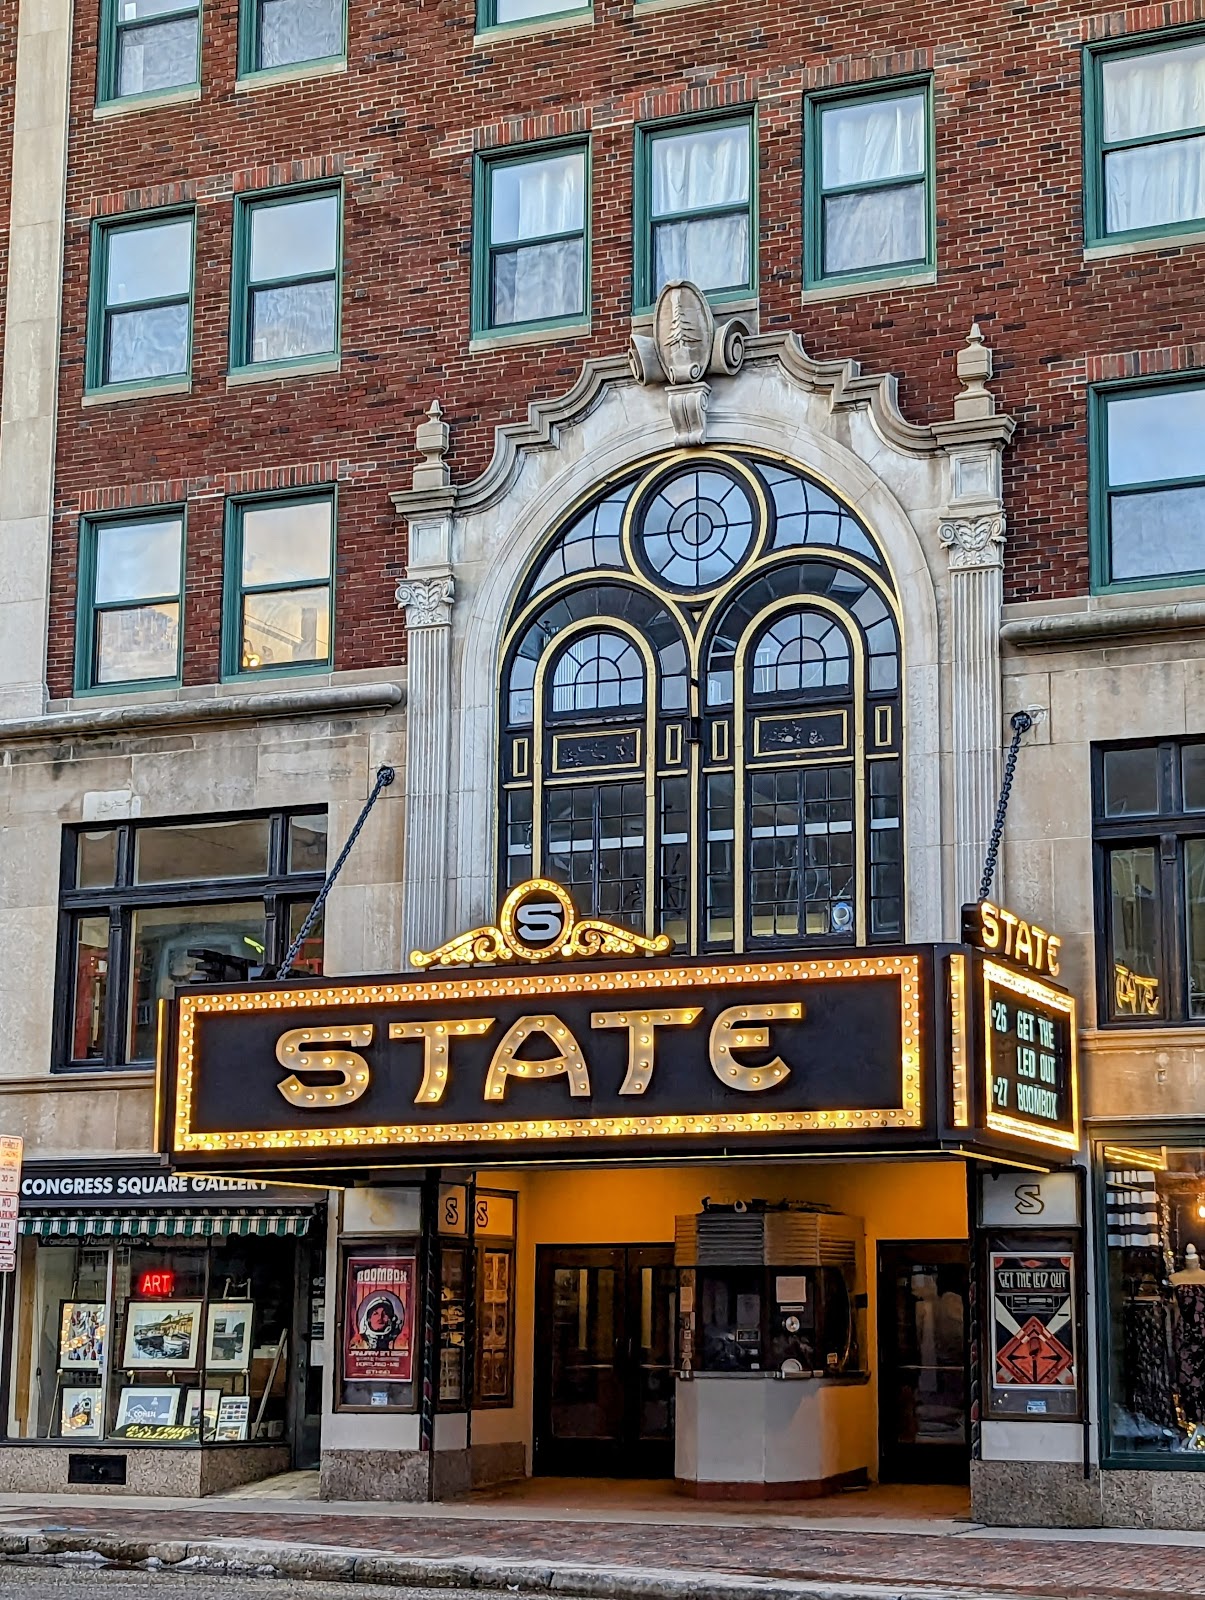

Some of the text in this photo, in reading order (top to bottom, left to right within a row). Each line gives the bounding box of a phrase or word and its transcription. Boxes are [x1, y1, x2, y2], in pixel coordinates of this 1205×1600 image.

[516, 903, 563, 941] S
[980, 901, 1062, 977] STATE
[1016, 1009, 1035, 1043] GET
[1037, 1017, 1056, 1051] THE
[275, 1002, 802, 1108] STATE
[1016, 1046, 1057, 1085] LED OUT
[1016, 1082, 1059, 1121] BOOMBOX
[21, 1177, 113, 1195] CONGRESS
[116, 1176, 188, 1195] SQUARE
[1014, 1184, 1045, 1215] S
[445, 1197, 458, 1226] S
[476, 1200, 489, 1228] S
[142, 1274, 171, 1293] ART
[356, 1267, 408, 1282] BOOMBOX
[997, 1271, 1014, 1288] GET
[1032, 1271, 1048, 1288] LED
[1049, 1271, 1067, 1288] OUT
